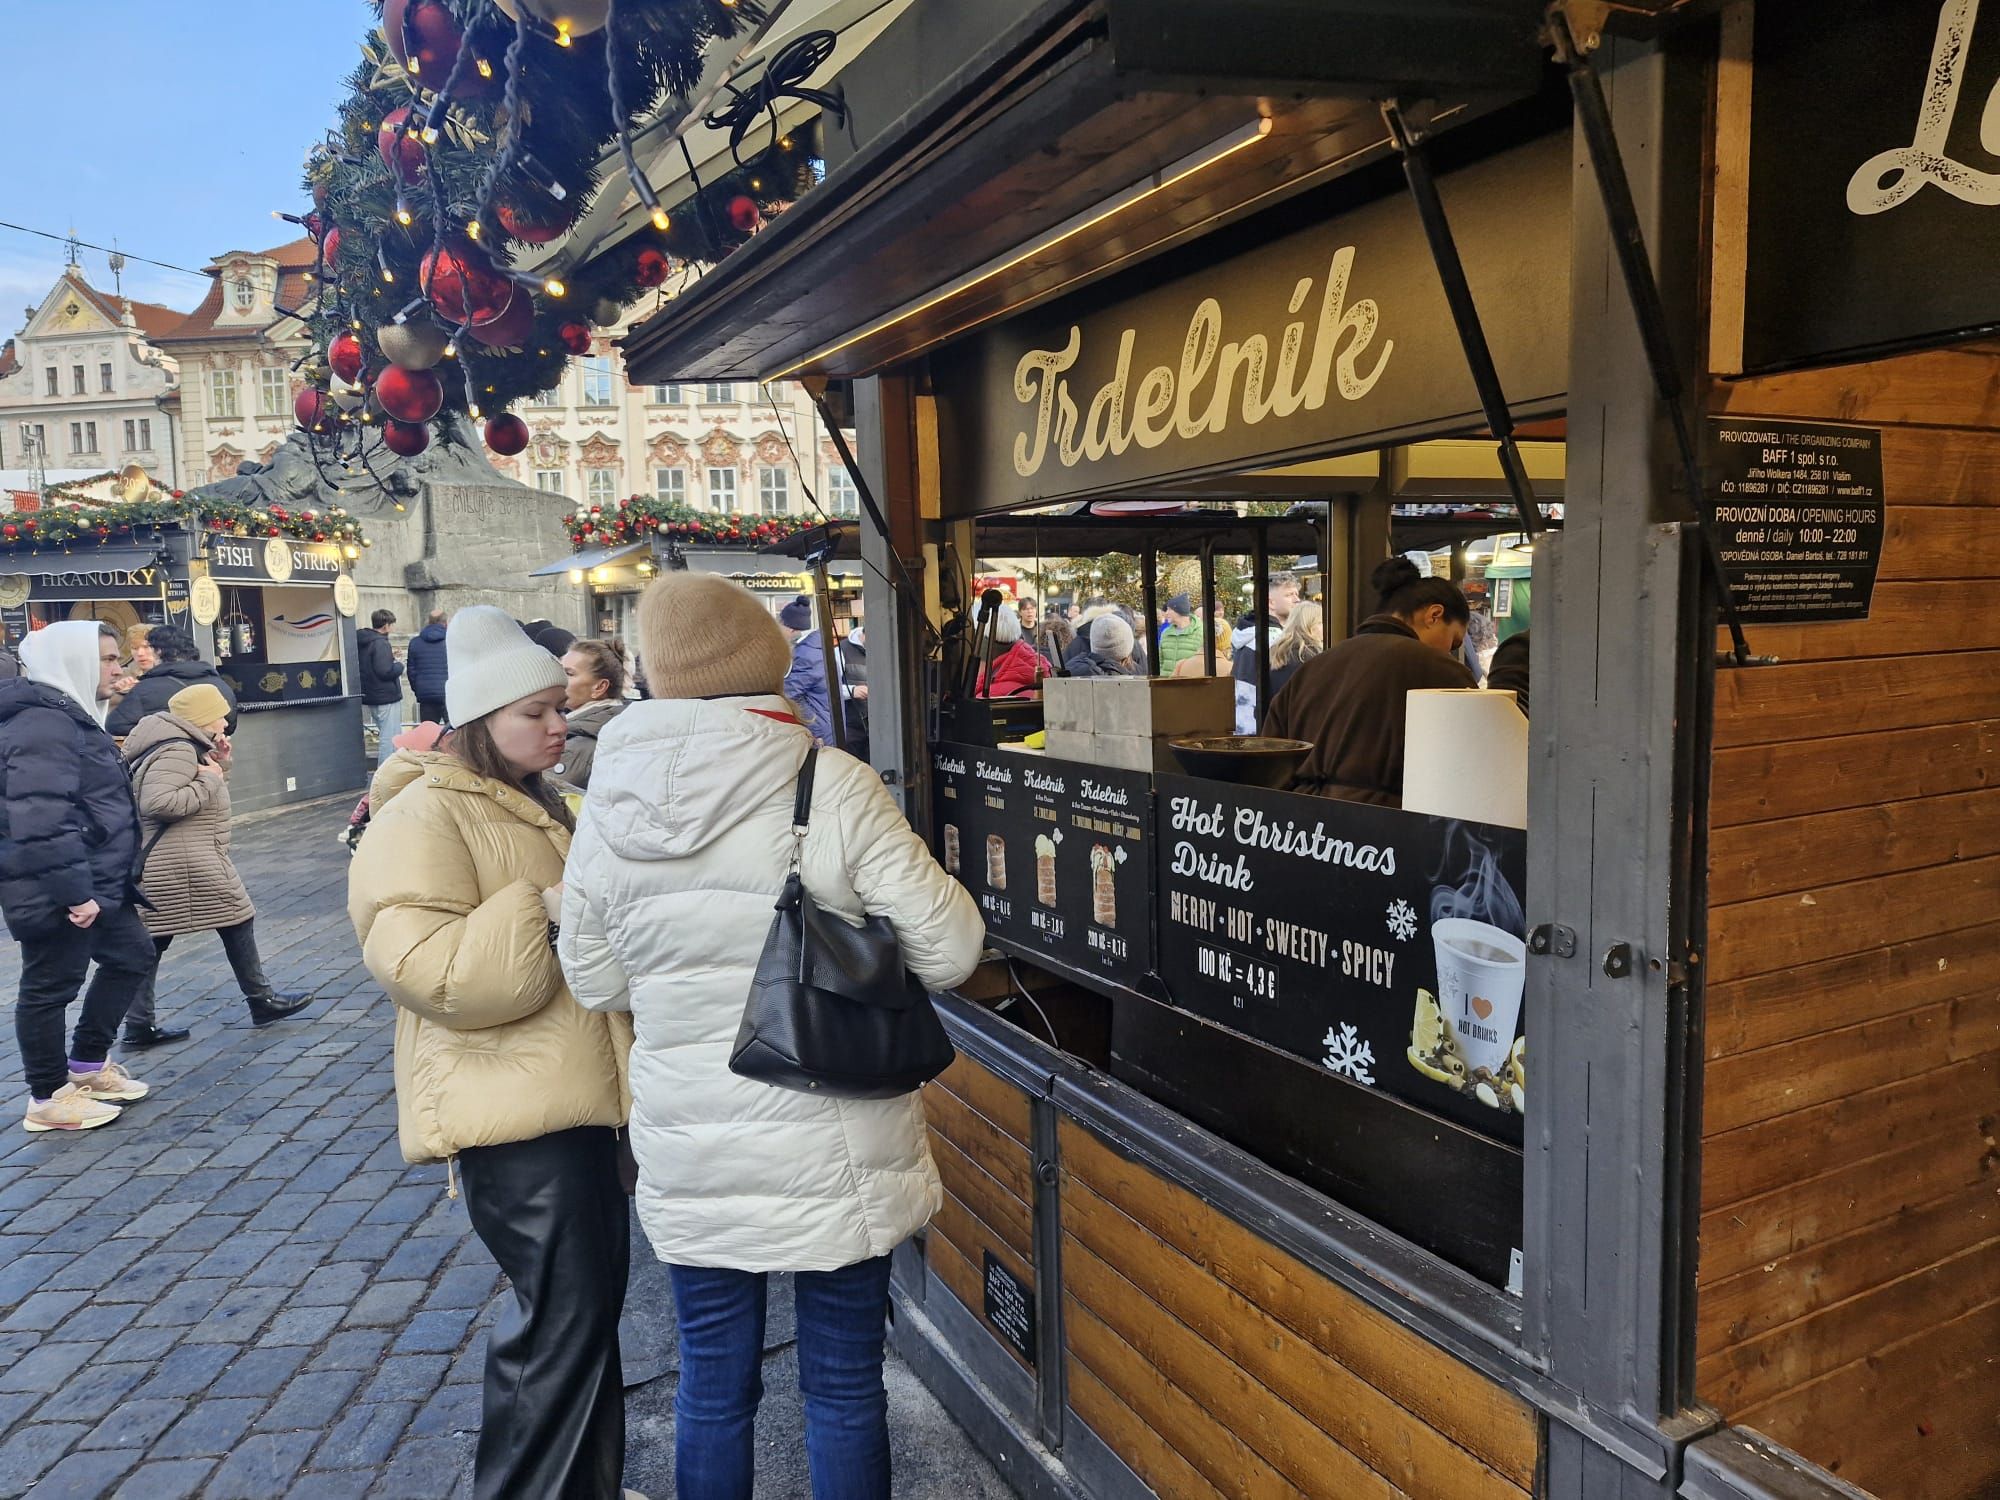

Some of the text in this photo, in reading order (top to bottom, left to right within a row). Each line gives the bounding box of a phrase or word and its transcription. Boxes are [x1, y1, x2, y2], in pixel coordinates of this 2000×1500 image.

[1847, 0, 2000, 215] L
[1720, 431, 1780, 444] PROVOZOVATEL
[1786, 434, 1799, 445] THE
[1801, 435, 1841, 447] ORGANIZING
[1842, 437, 1871, 448] COMPANY
[1763, 449, 1839, 467] BAFF 1 spol. s r.o.
[1767, 468, 1791, 479] Wolkera
[1810, 469, 1822, 479] 258
[1715, 504, 1767, 522] PROVOZNÍ
[1769, 508, 1795, 522] DOBA
[1802, 509, 1843, 523] OPENING
[1845, 509, 1876, 524] HOURS
[1736, 528, 1764, 543] denně
[1773, 529, 1793, 545] daily
[1799, 529, 1823, 542] 10:00
[1832, 529, 1856, 543] 22:00
[216, 546, 254, 567] FISH
[293, 551, 338, 572] STRIPS
[1170, 797, 1225, 838] Hot
[1234, 806, 1396, 876] Christmas
[1171, 841, 1254, 892] Drink
[1171, 890, 1395, 989] MERRY HOT SWEETY SPICY
[1198, 946, 1215, 976] 100
[1219, 952, 1231, 982] KČ
[1247, 963, 1264, 996] 4,3
[1268, 971, 1275, 999] €
[1465, 993, 1468, 1016] I
[1458, 1019, 1497, 1044] HOT DRINKS
